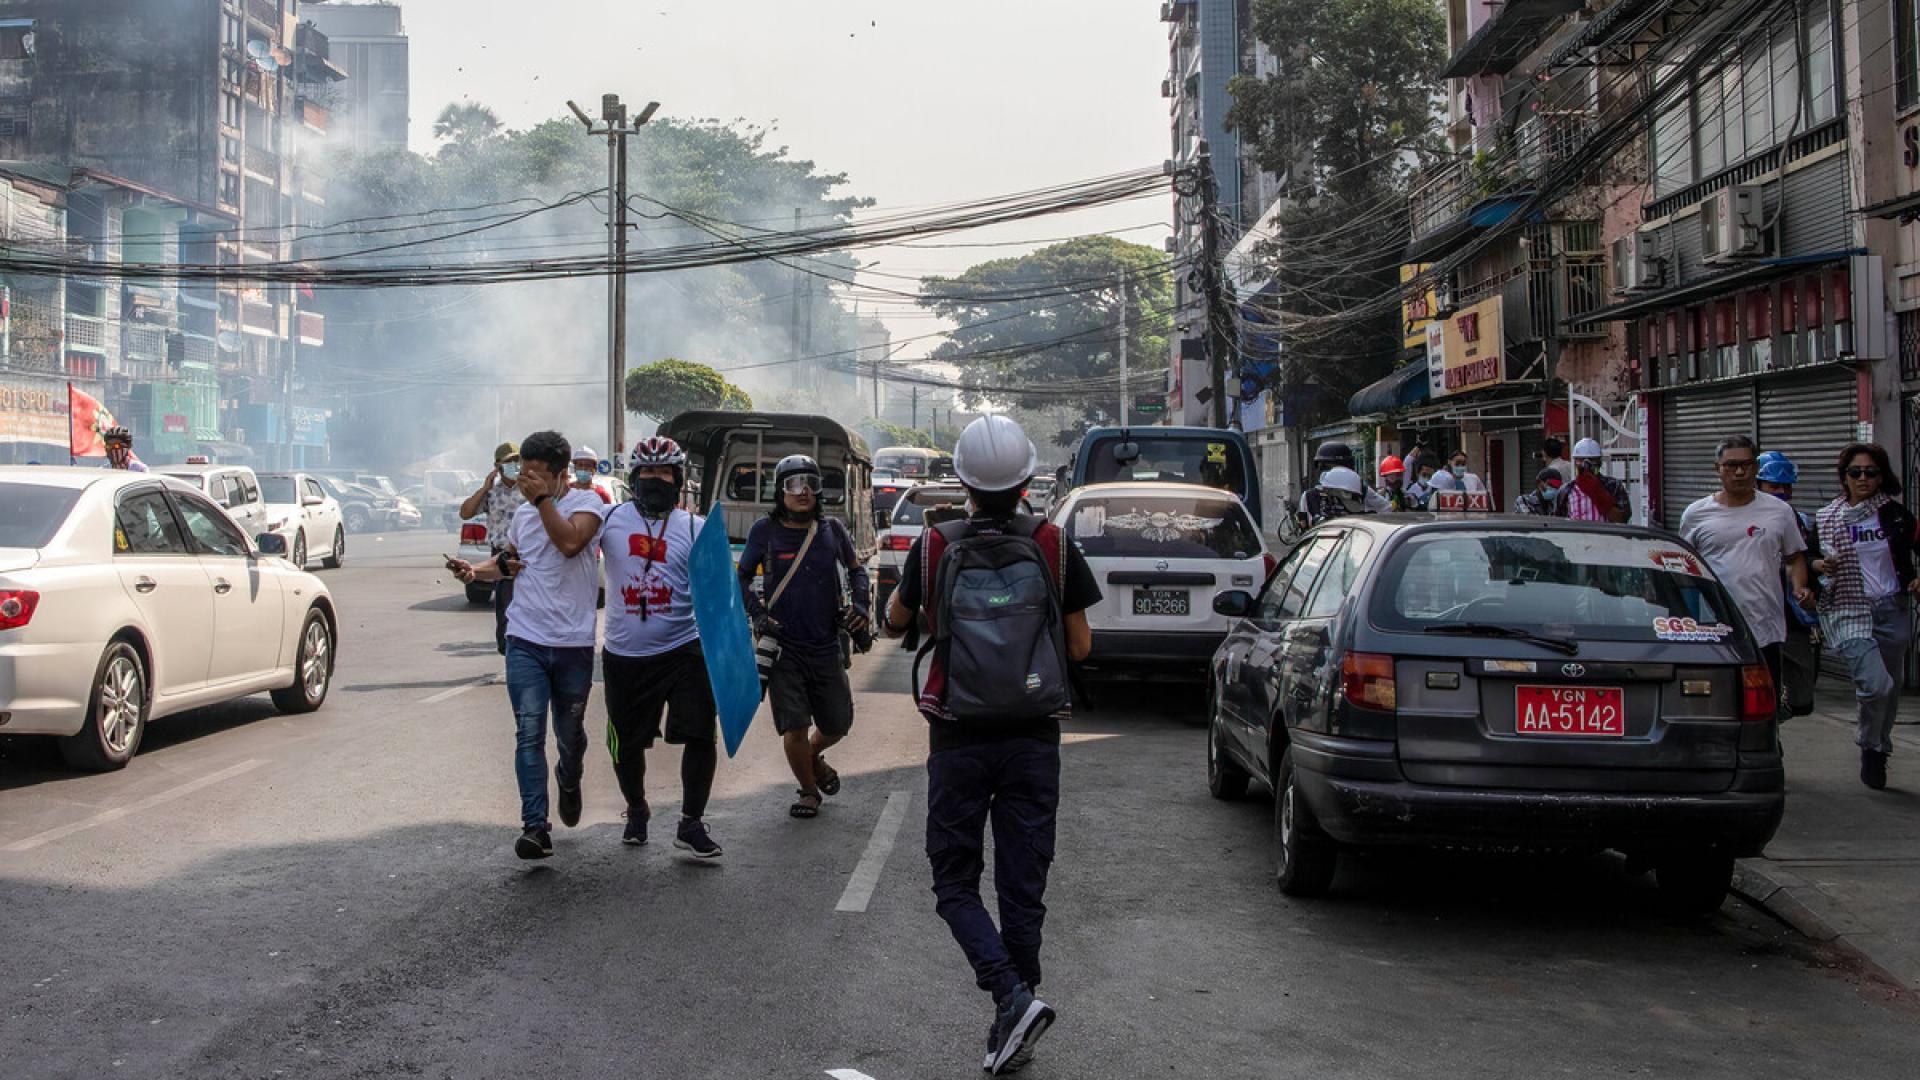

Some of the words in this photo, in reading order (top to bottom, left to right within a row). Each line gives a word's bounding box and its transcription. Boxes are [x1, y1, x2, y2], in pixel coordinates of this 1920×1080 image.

[0, 387, 17, 409] OT
[1441, 494, 1487, 509] TAXI
[1654, 617, 1697, 633] SGS
[1551, 689, 1585, 703] YGN
[1523, 703, 1616, 730] AA-5142
